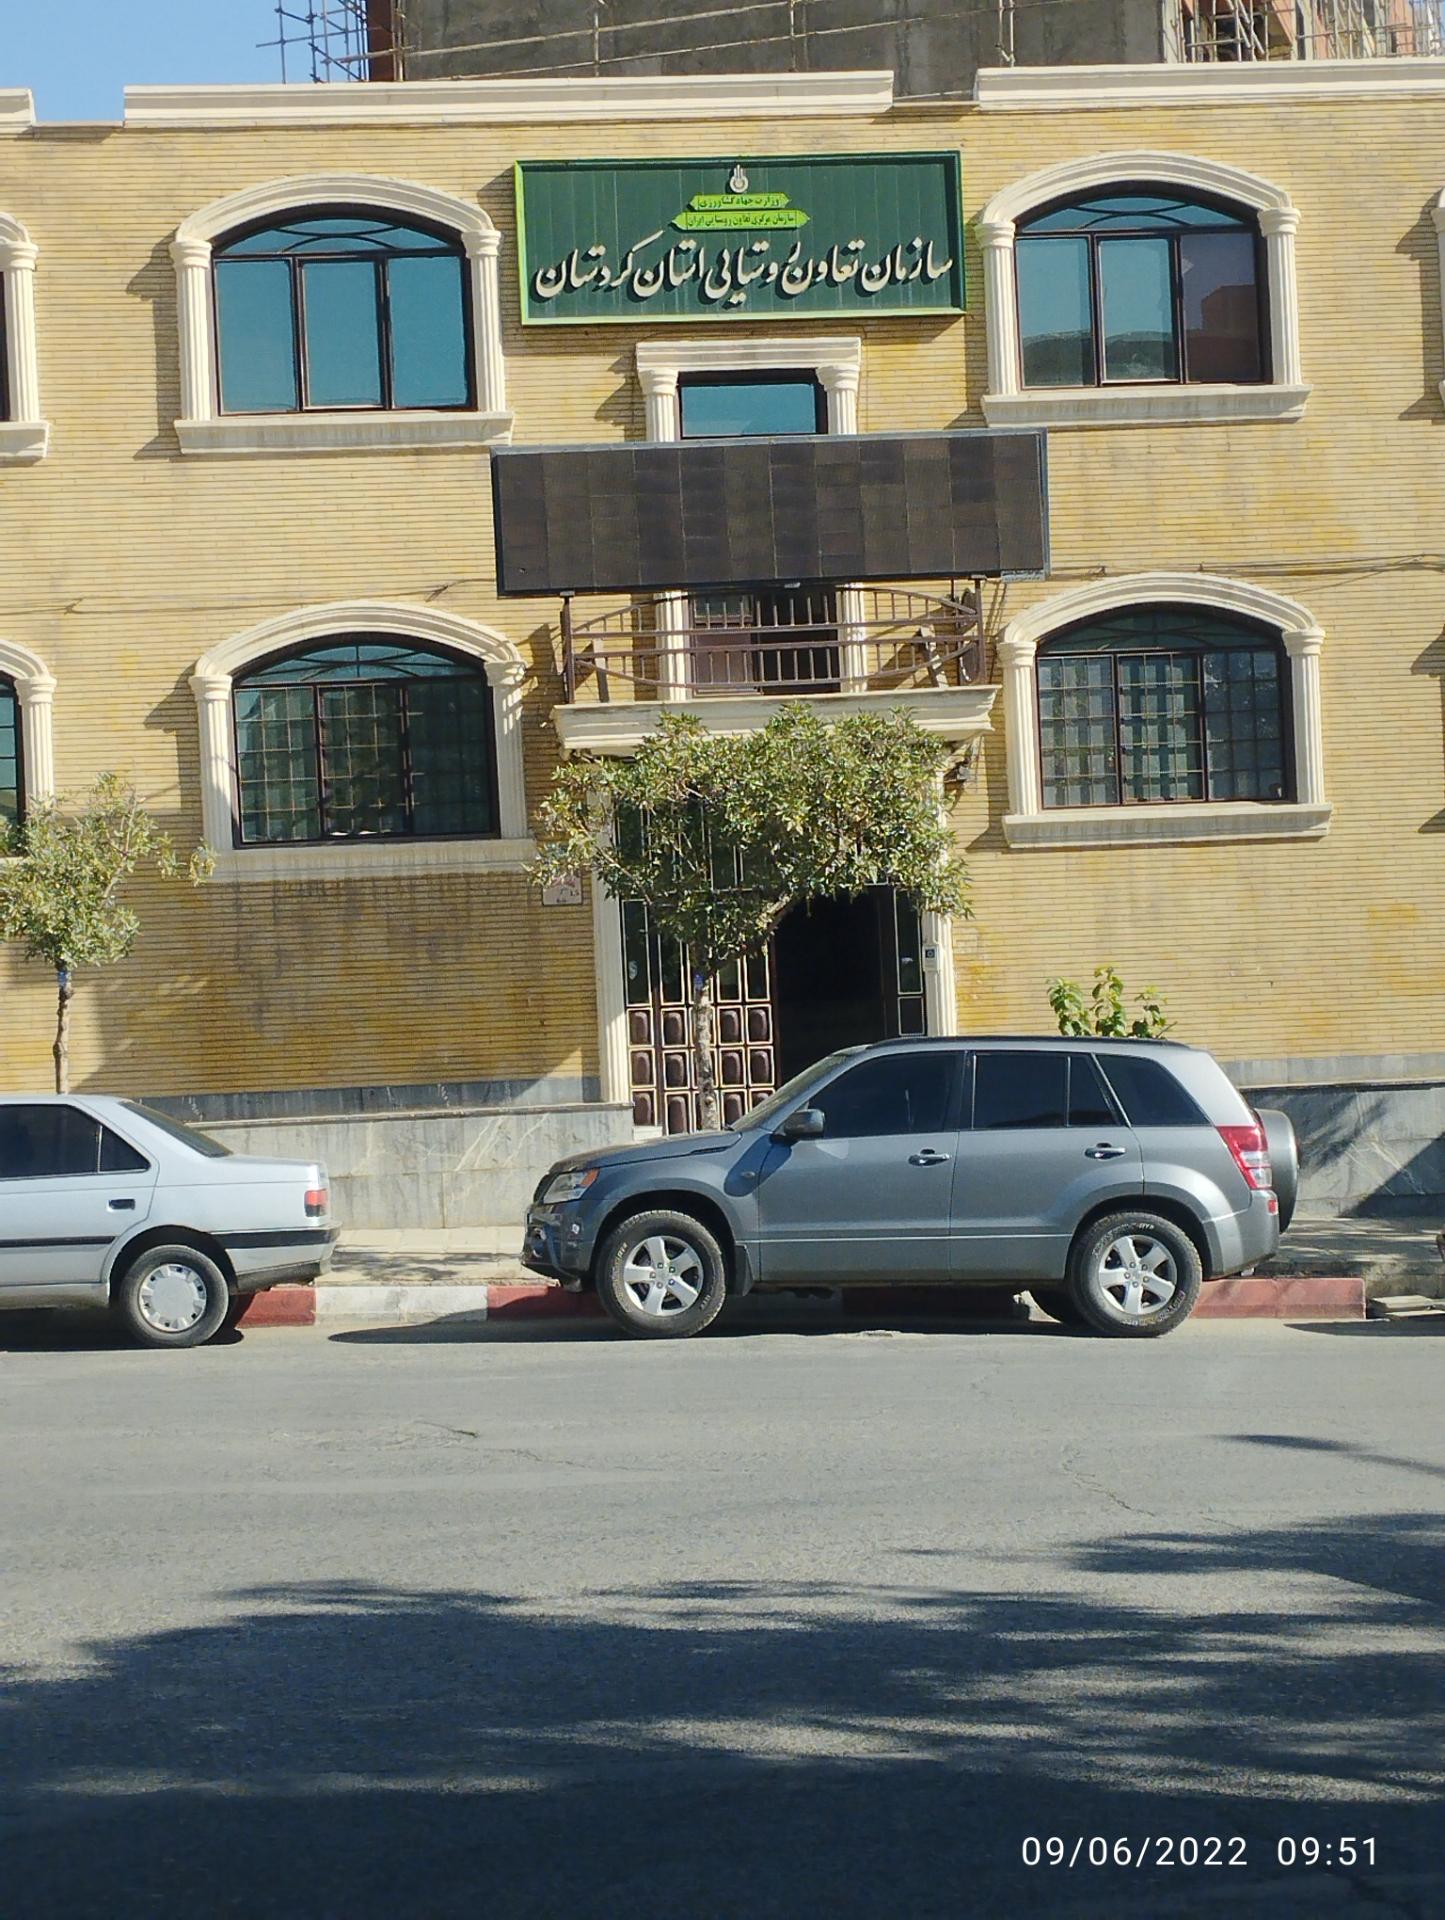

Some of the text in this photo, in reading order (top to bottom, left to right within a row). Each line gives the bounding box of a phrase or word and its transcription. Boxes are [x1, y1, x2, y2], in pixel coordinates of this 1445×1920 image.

[699, 196, 780, 208] وزارت جهاد کشاورزی
[687, 213, 794, 227] سازمان مرکزی تعاون روستایی ایران
[535, 230, 953, 305] سازمان تعاون روستایی استان کردستان
